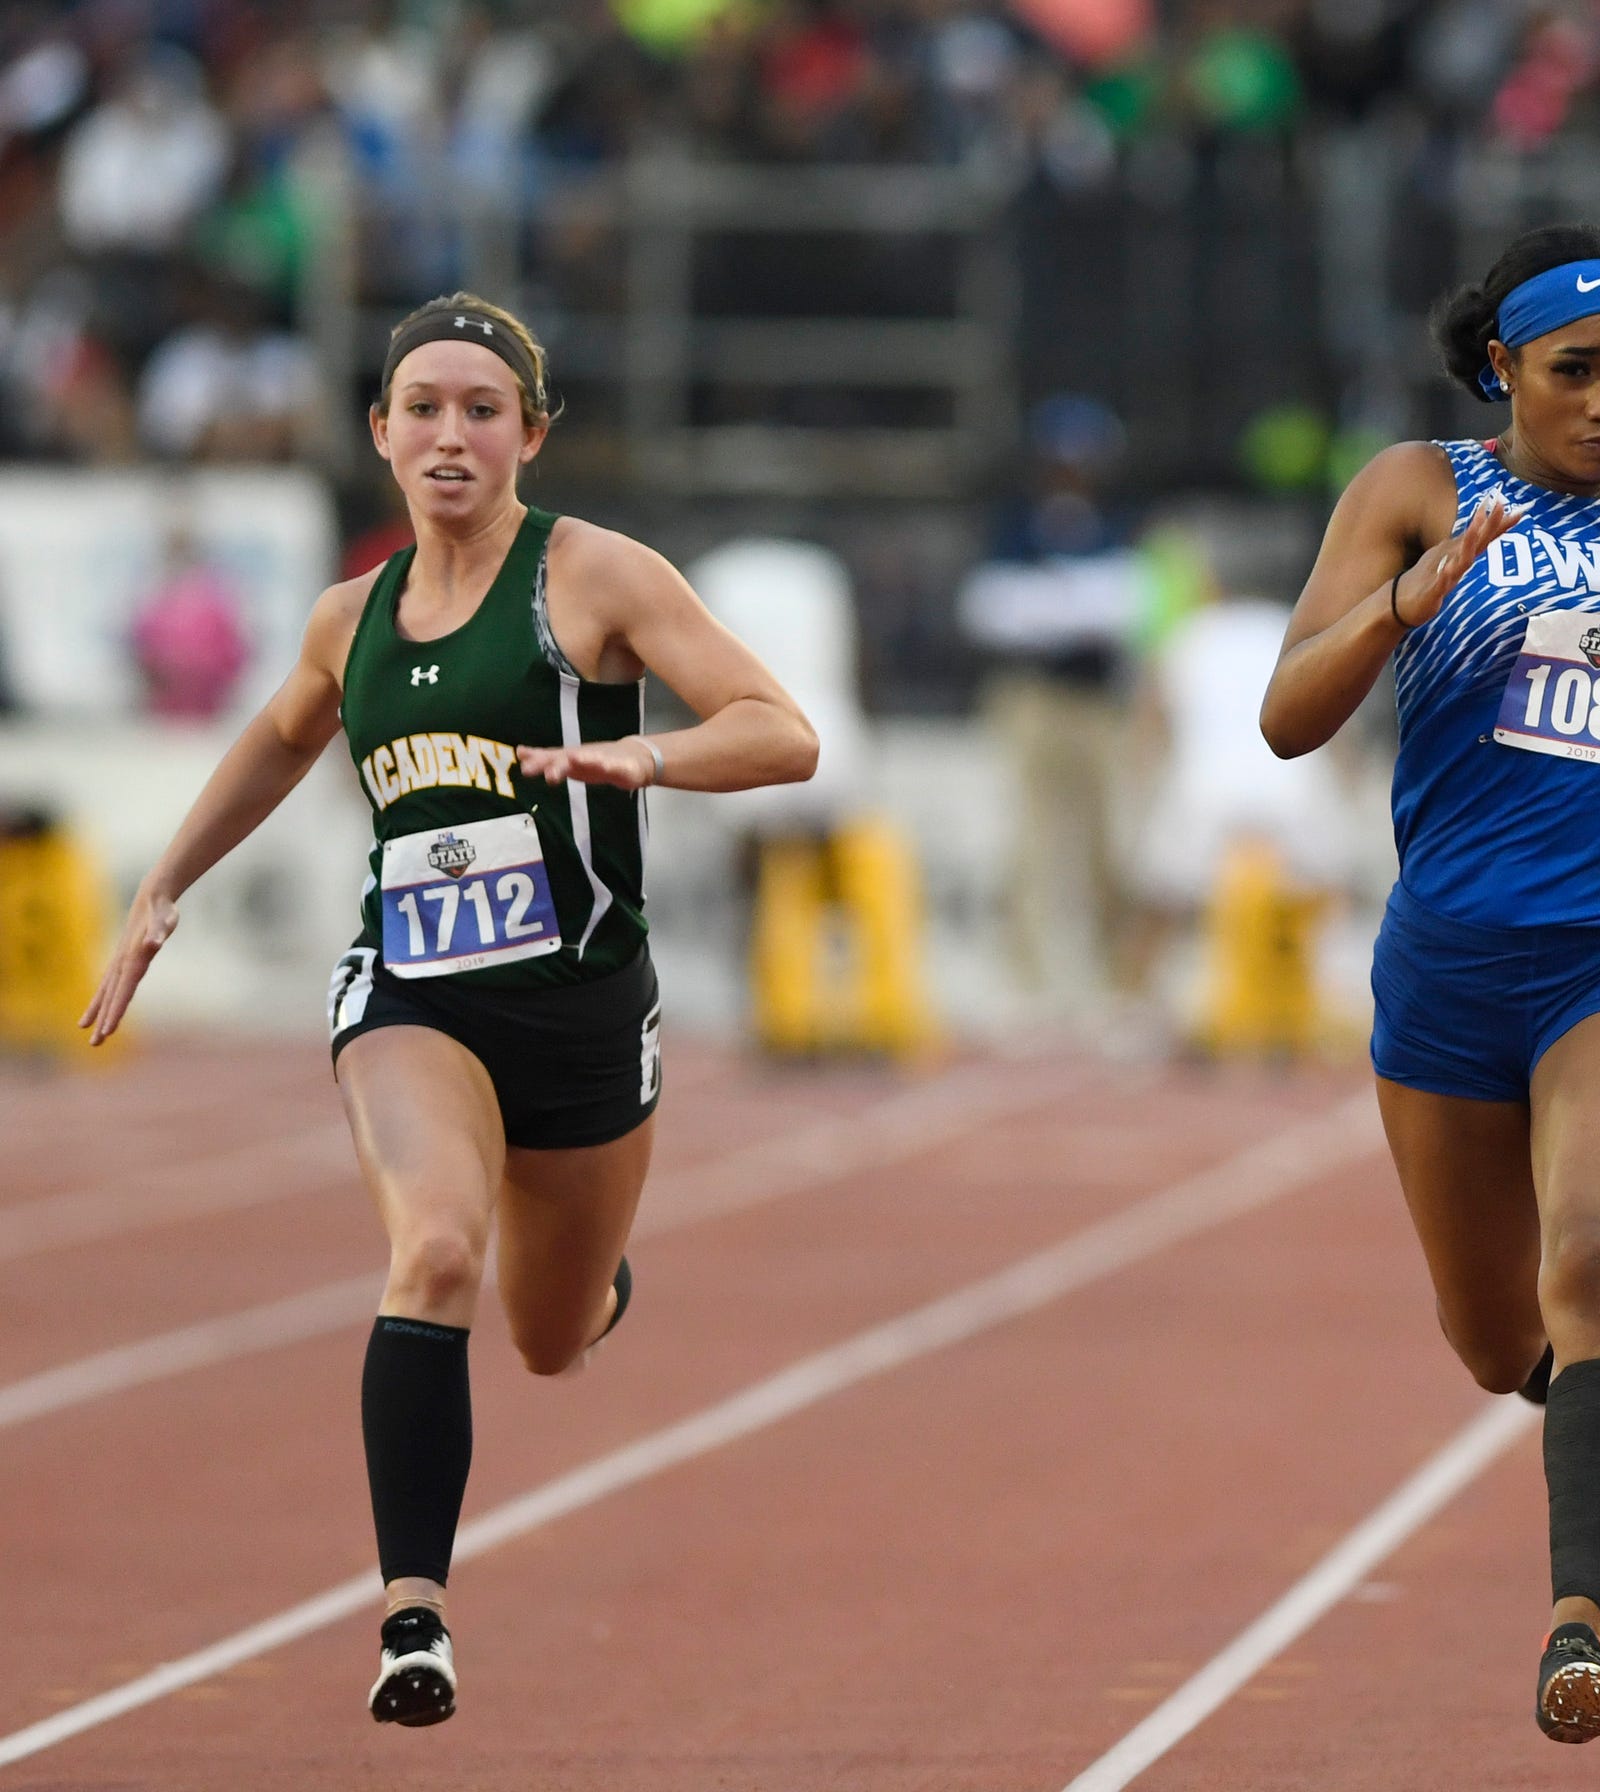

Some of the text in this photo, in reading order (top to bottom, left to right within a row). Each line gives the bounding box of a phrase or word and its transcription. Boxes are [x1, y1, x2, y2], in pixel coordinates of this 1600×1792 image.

[1567, 746, 1596, 759] 2019
[429, 845, 475, 866] STATE
[398, 872, 544, 957] 1712
